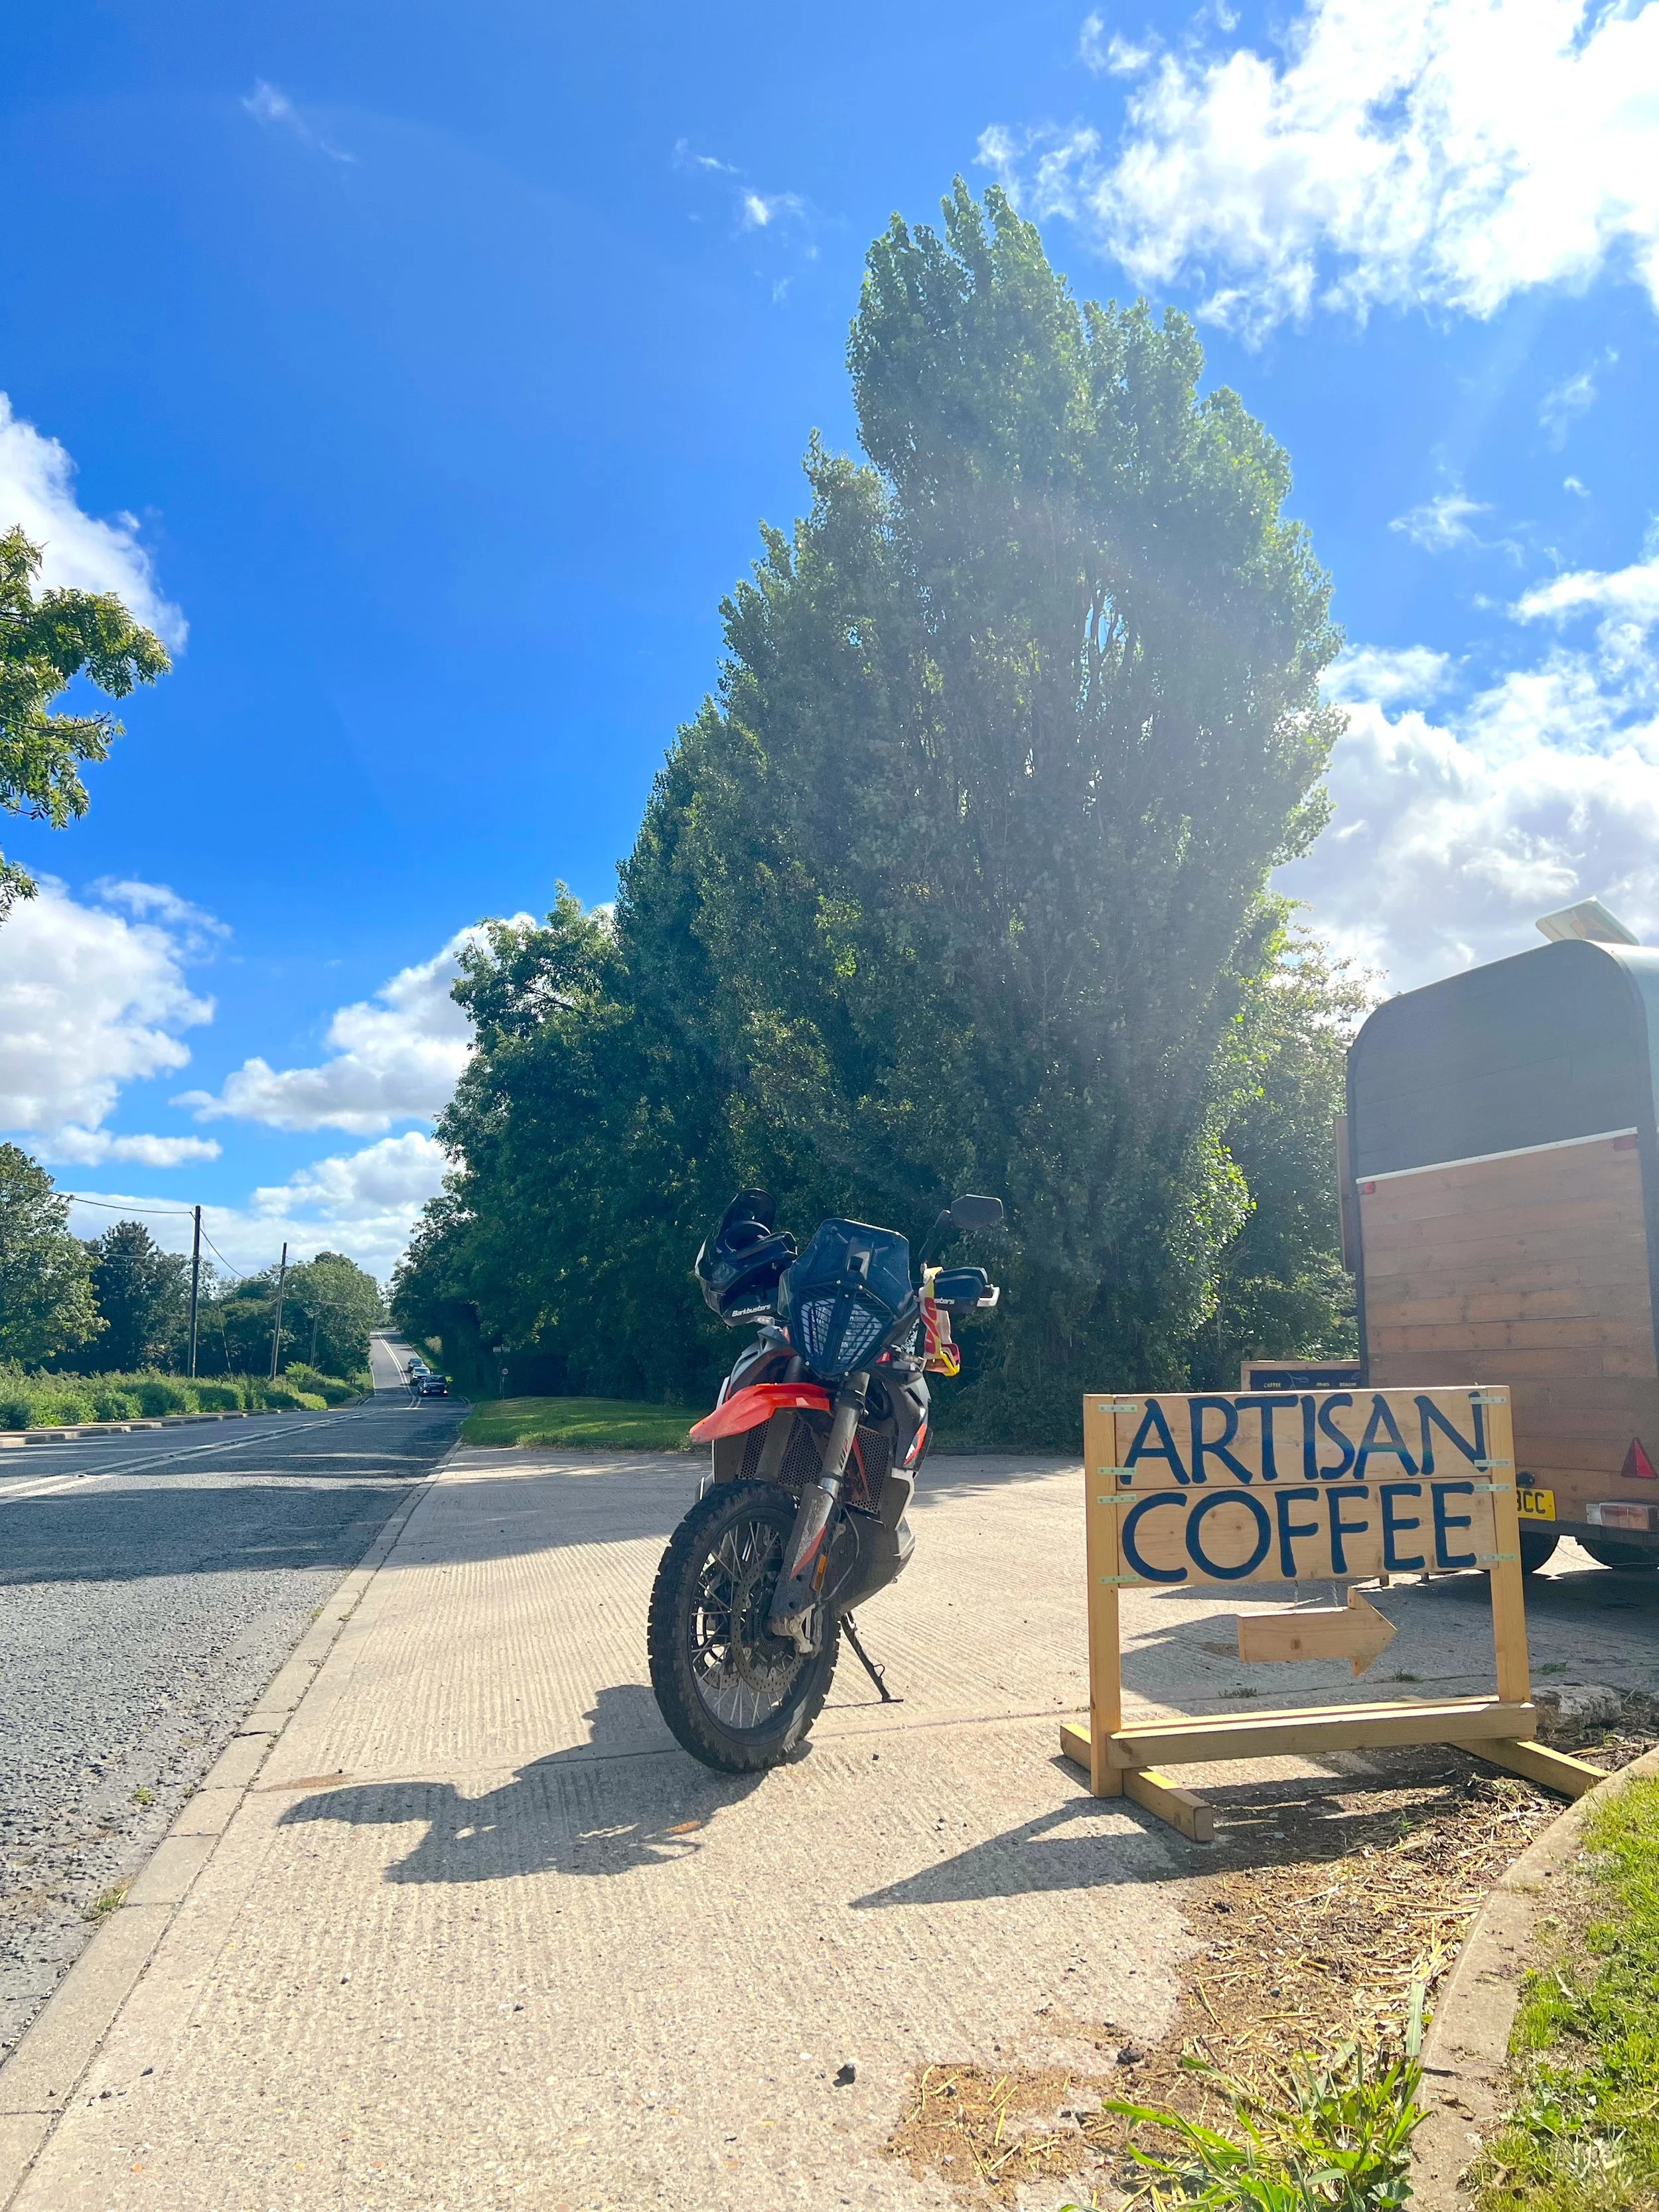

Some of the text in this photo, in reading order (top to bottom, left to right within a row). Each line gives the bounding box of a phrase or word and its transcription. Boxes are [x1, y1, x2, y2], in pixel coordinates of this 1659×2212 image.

[732, 1304, 771, 1317] Barkbusters
[1119, 1391, 1488, 1485] ARTISAN
[1122, 1481, 1477, 1583] COFFEE
